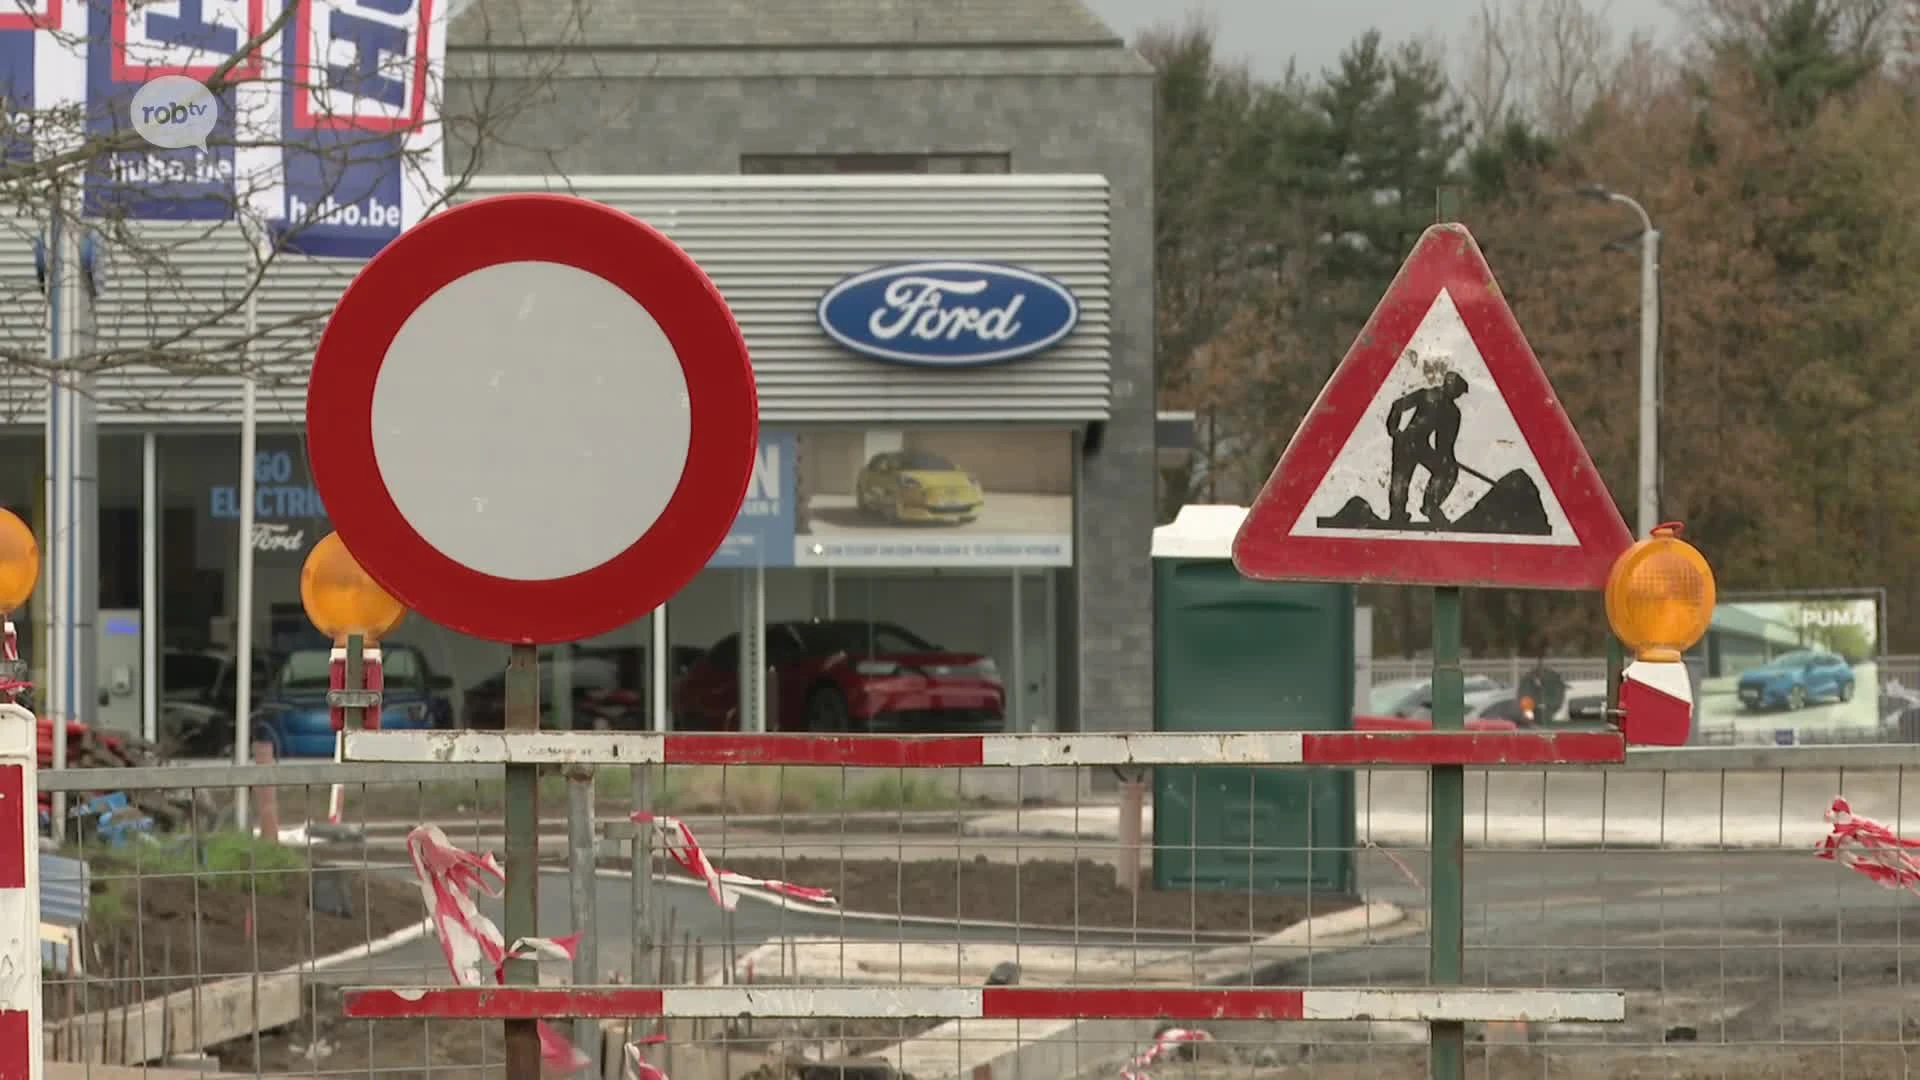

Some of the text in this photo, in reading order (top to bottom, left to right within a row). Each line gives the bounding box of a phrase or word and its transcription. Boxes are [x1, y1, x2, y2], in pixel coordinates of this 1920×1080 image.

[868, 276, 1026, 341] Ford
[210, 486, 327, 518] ELCTRI
[1802, 608, 1865, 627] PUMA
